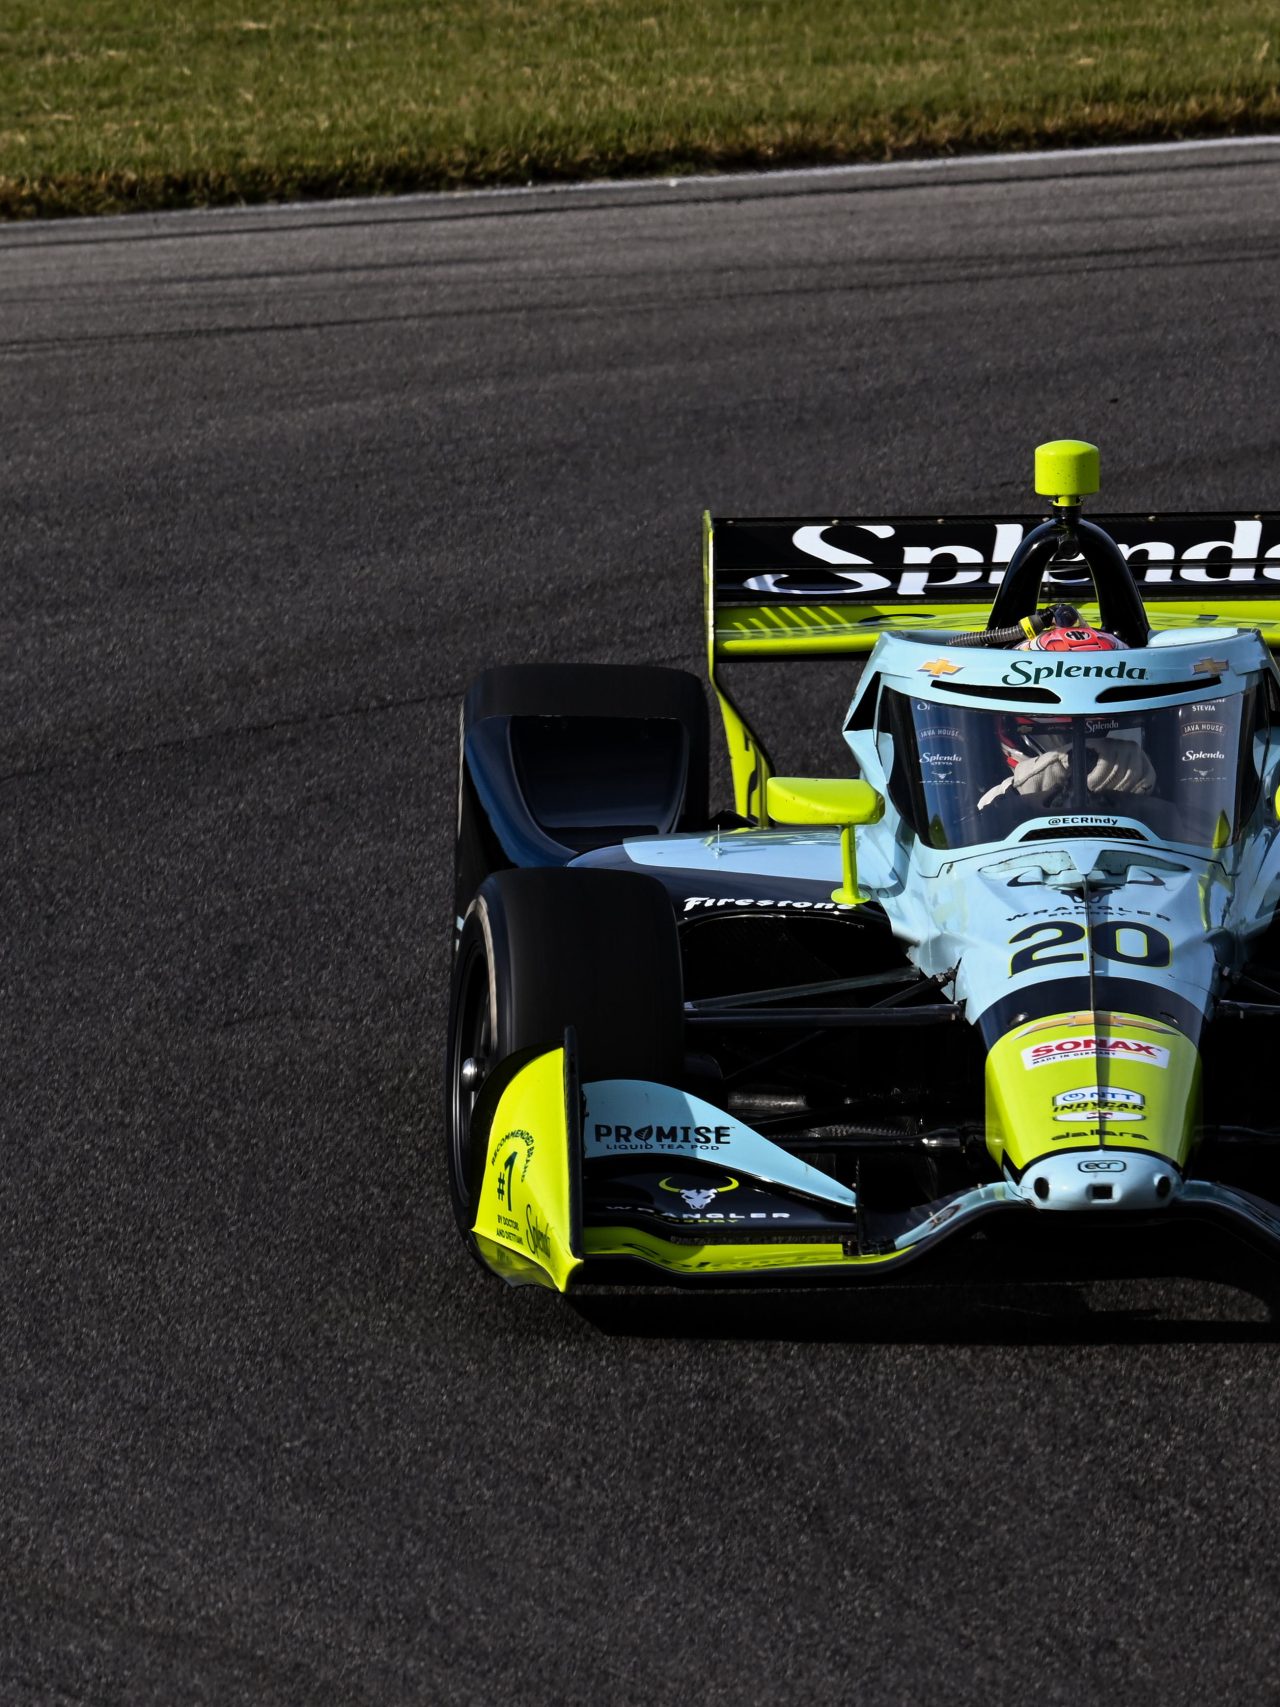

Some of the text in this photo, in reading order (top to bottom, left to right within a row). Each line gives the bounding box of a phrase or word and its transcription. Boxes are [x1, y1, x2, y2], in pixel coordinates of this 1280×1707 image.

[1001, 660, 1148, 686] Splenda
[1192, 704, 1216, 712] STEVIA
[1086, 720, 1119, 733] Splenda
[1184, 724, 1223, 733] JAVA HOUSE
[920, 728, 960, 738] JAVA HOUSE
[919, 752, 962, 763] Splenda
[1182, 750, 1225, 761] Splenda
[1048, 816, 1119, 825] @ECRIndy
[683, 896, 856, 912] Firestone
[1005, 905, 1171, 922] WRANGLER
[1008, 920, 1172, 978] 20
[1031, 1038, 1157, 1057] SONAX
[1090, 1091, 1135, 1100] NTT
[1052, 1101, 1145, 1112] INDYCAR
[594, 1124, 731, 1144] PROMISE
[1051, 1129, 1149, 1141] dallara
[605, 1205, 790, 1219] WRANGLER
